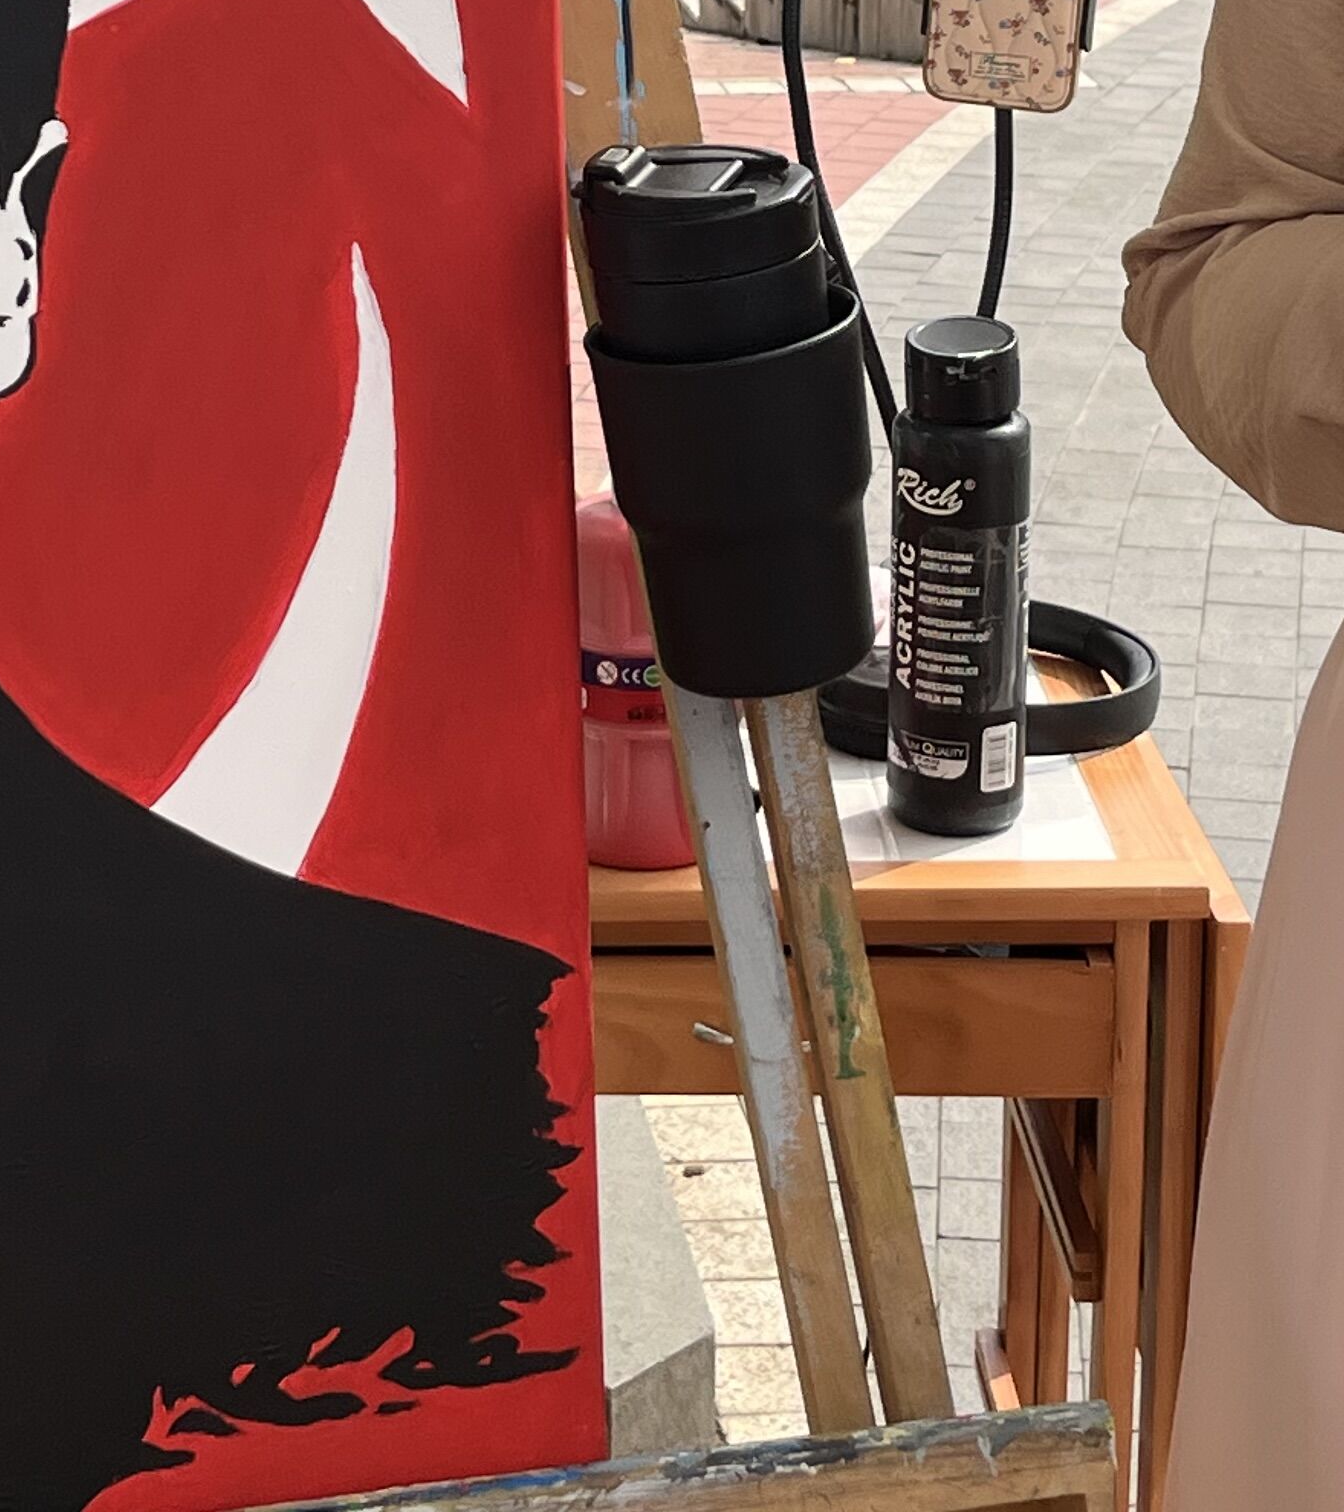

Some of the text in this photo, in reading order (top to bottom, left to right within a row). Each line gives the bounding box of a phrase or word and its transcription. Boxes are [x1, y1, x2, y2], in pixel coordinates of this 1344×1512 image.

[896, 467, 964, 517] Rich
[895, 541, 917, 690] ACRYLIC
[922, 741, 966, 759] QUALITY
